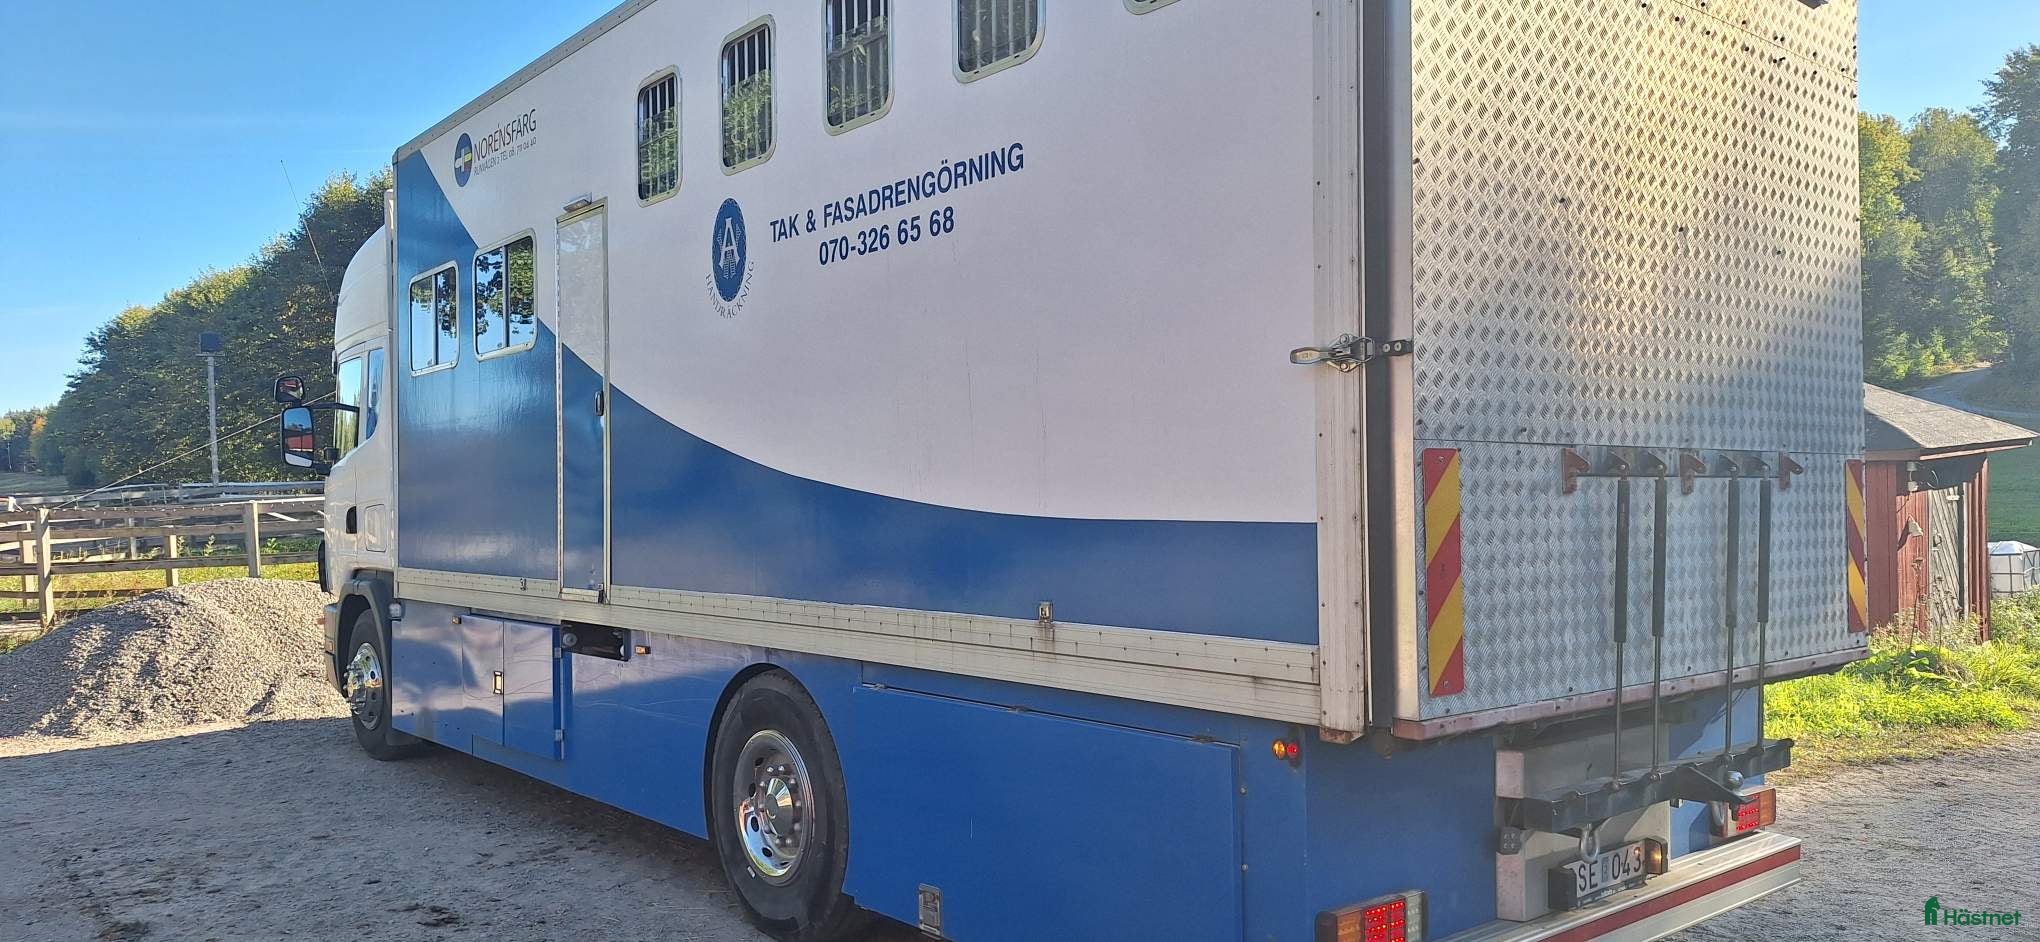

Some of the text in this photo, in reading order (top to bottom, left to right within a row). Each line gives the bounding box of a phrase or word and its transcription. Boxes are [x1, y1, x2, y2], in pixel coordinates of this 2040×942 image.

[770, 142, 1025, 243] TAK & FASADRENGÖRNING
[819, 206, 954, 266] 070-326 65 68
[1611, 846, 1641, 881] 043
